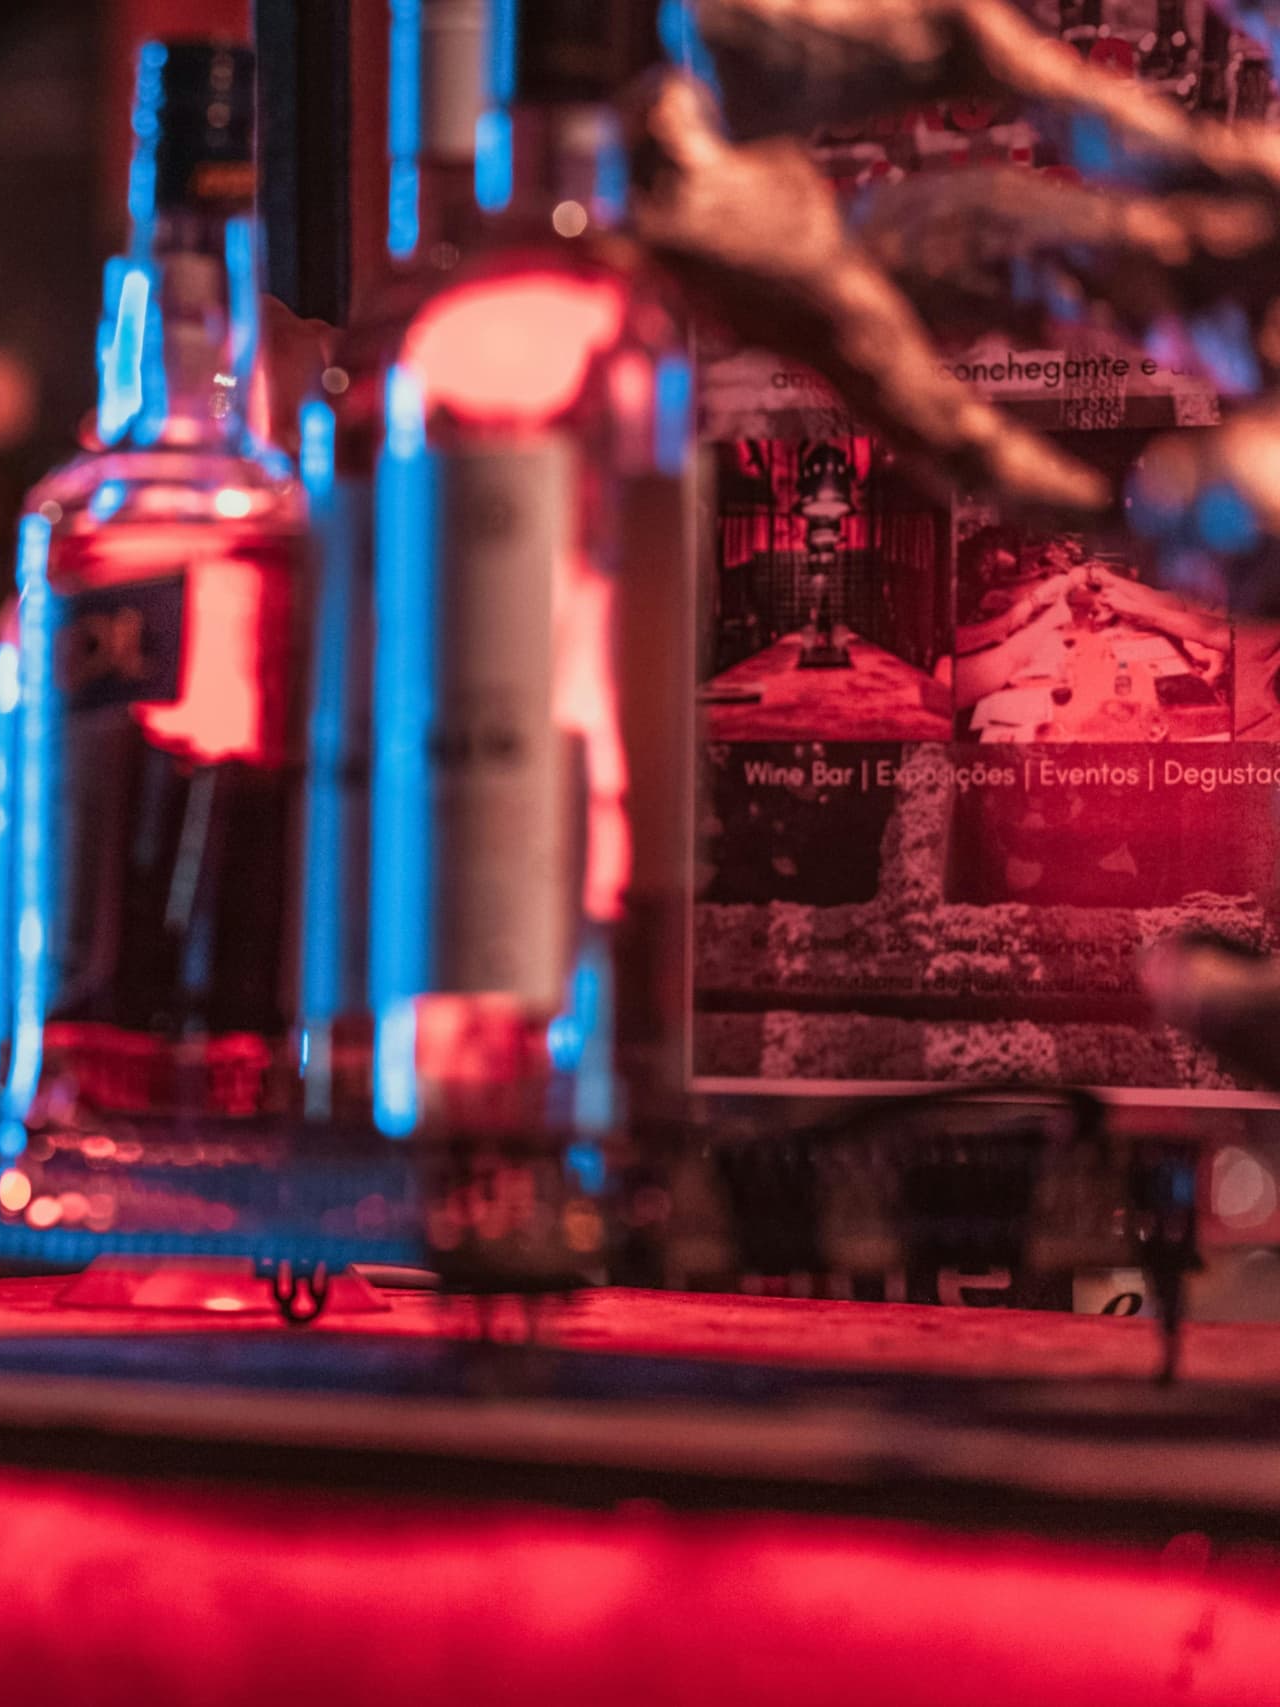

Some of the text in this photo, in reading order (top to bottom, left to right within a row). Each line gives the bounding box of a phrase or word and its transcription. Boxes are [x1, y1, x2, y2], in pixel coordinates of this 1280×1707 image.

[932, 352, 1129, 388] conchegante
[1141, 358, 1158, 376] e
[743, 760, 805, 787] Wine
[811, 759, 855, 787] Bar
[876, 760, 1016, 793] Exposições
[1039, 760, 1140, 787] Eventos
